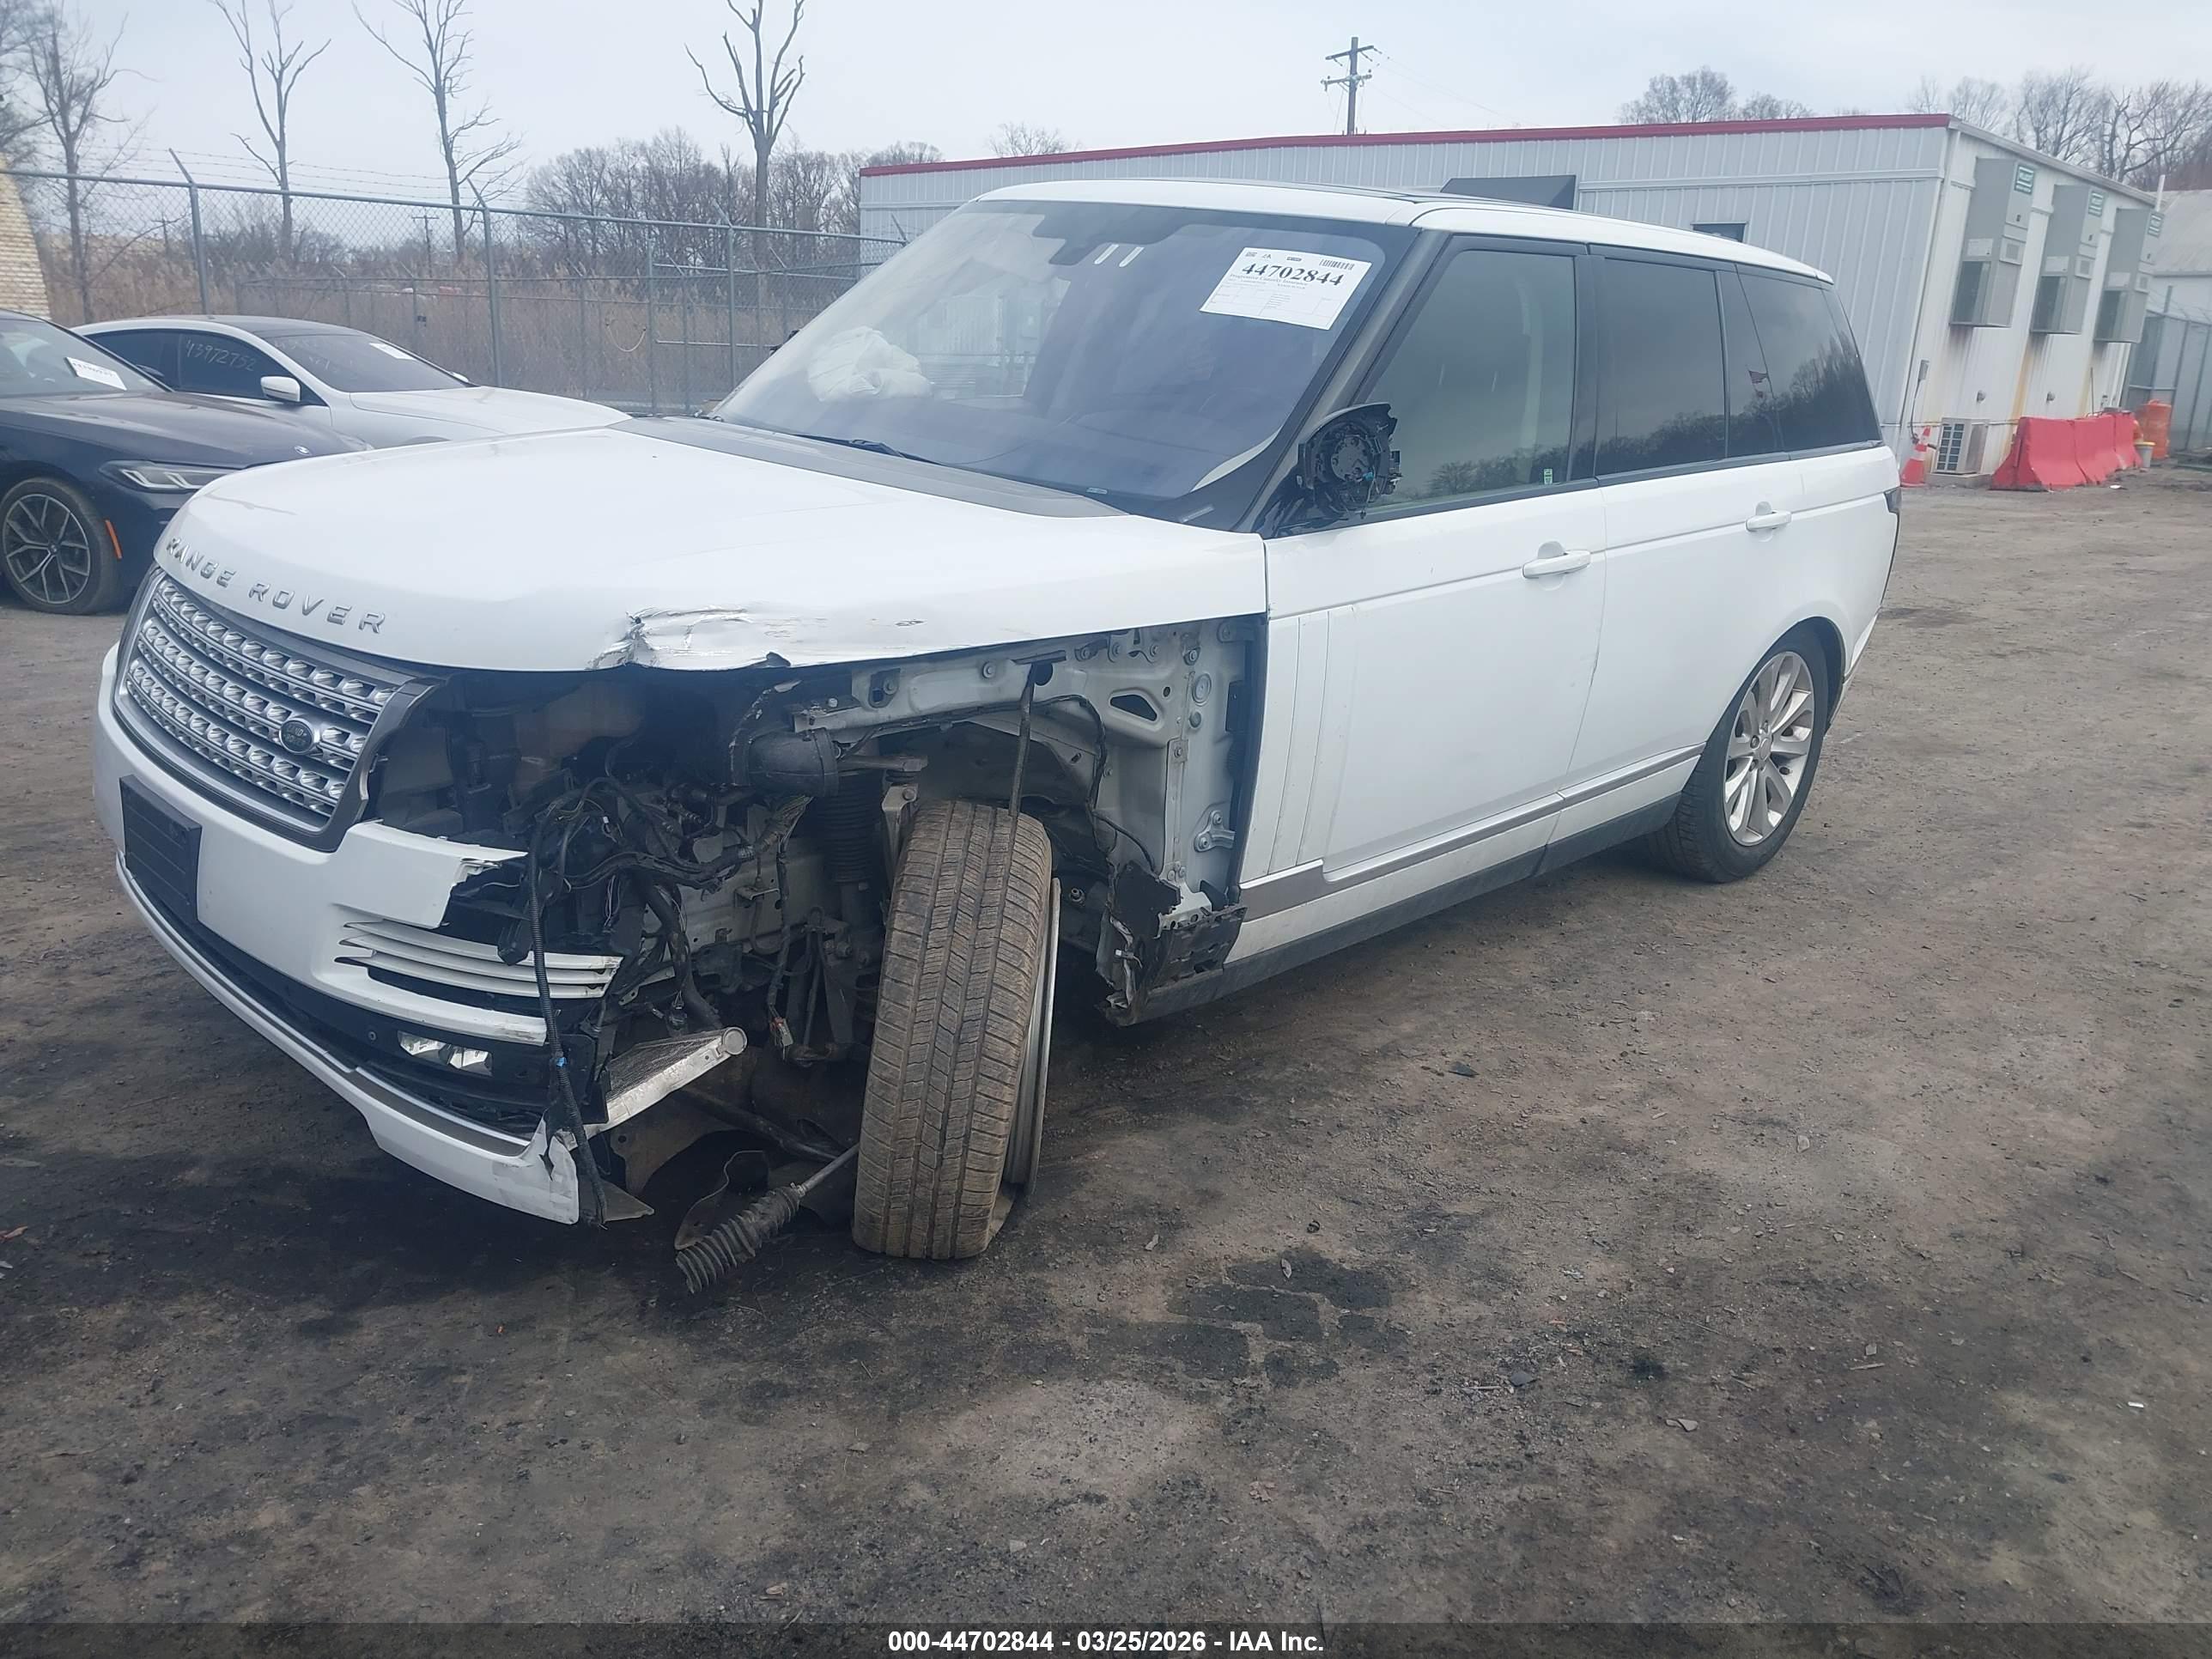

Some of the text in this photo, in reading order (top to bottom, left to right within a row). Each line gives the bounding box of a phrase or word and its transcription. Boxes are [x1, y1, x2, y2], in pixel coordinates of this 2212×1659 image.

[1242, 263, 1345, 286] 44702844
[166, 537, 386, 634] RANGE ROVER
